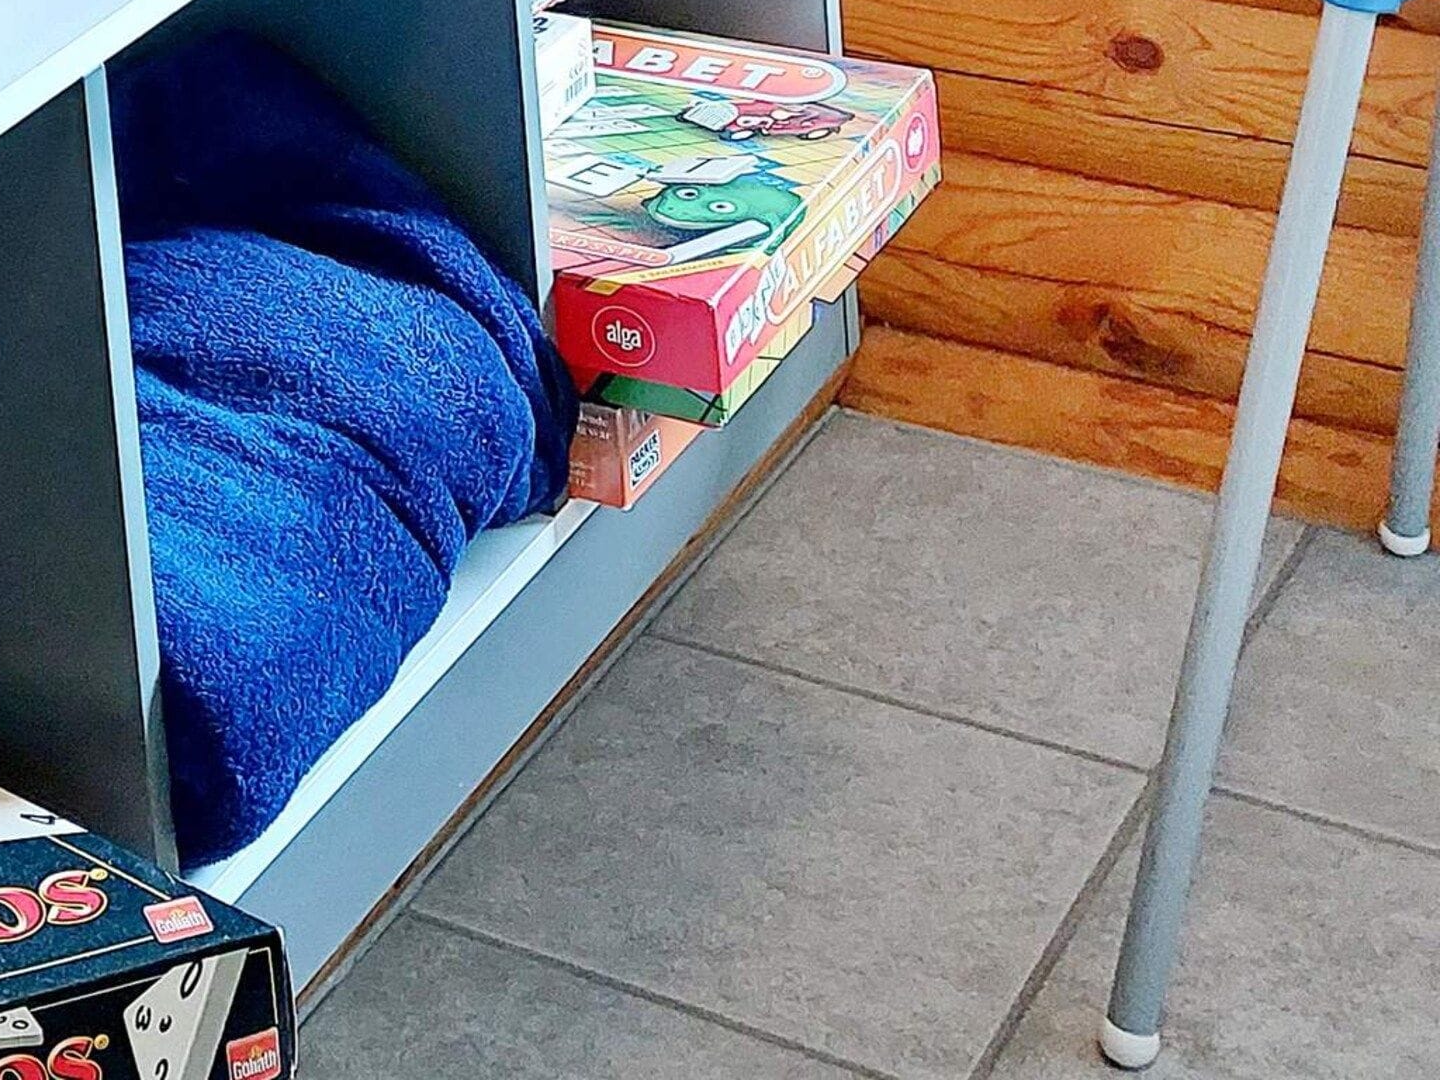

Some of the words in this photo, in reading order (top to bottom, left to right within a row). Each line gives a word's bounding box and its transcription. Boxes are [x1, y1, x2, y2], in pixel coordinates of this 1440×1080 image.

[567, 161, 624, 186] E
[686, 156, 727, 173] T
[779, 165, 887, 305] ALFABET
[606, 320, 642, 351] alga
[155, 910, 206, 935] Goliath
[232, 1048, 278, 1080] Goliath
